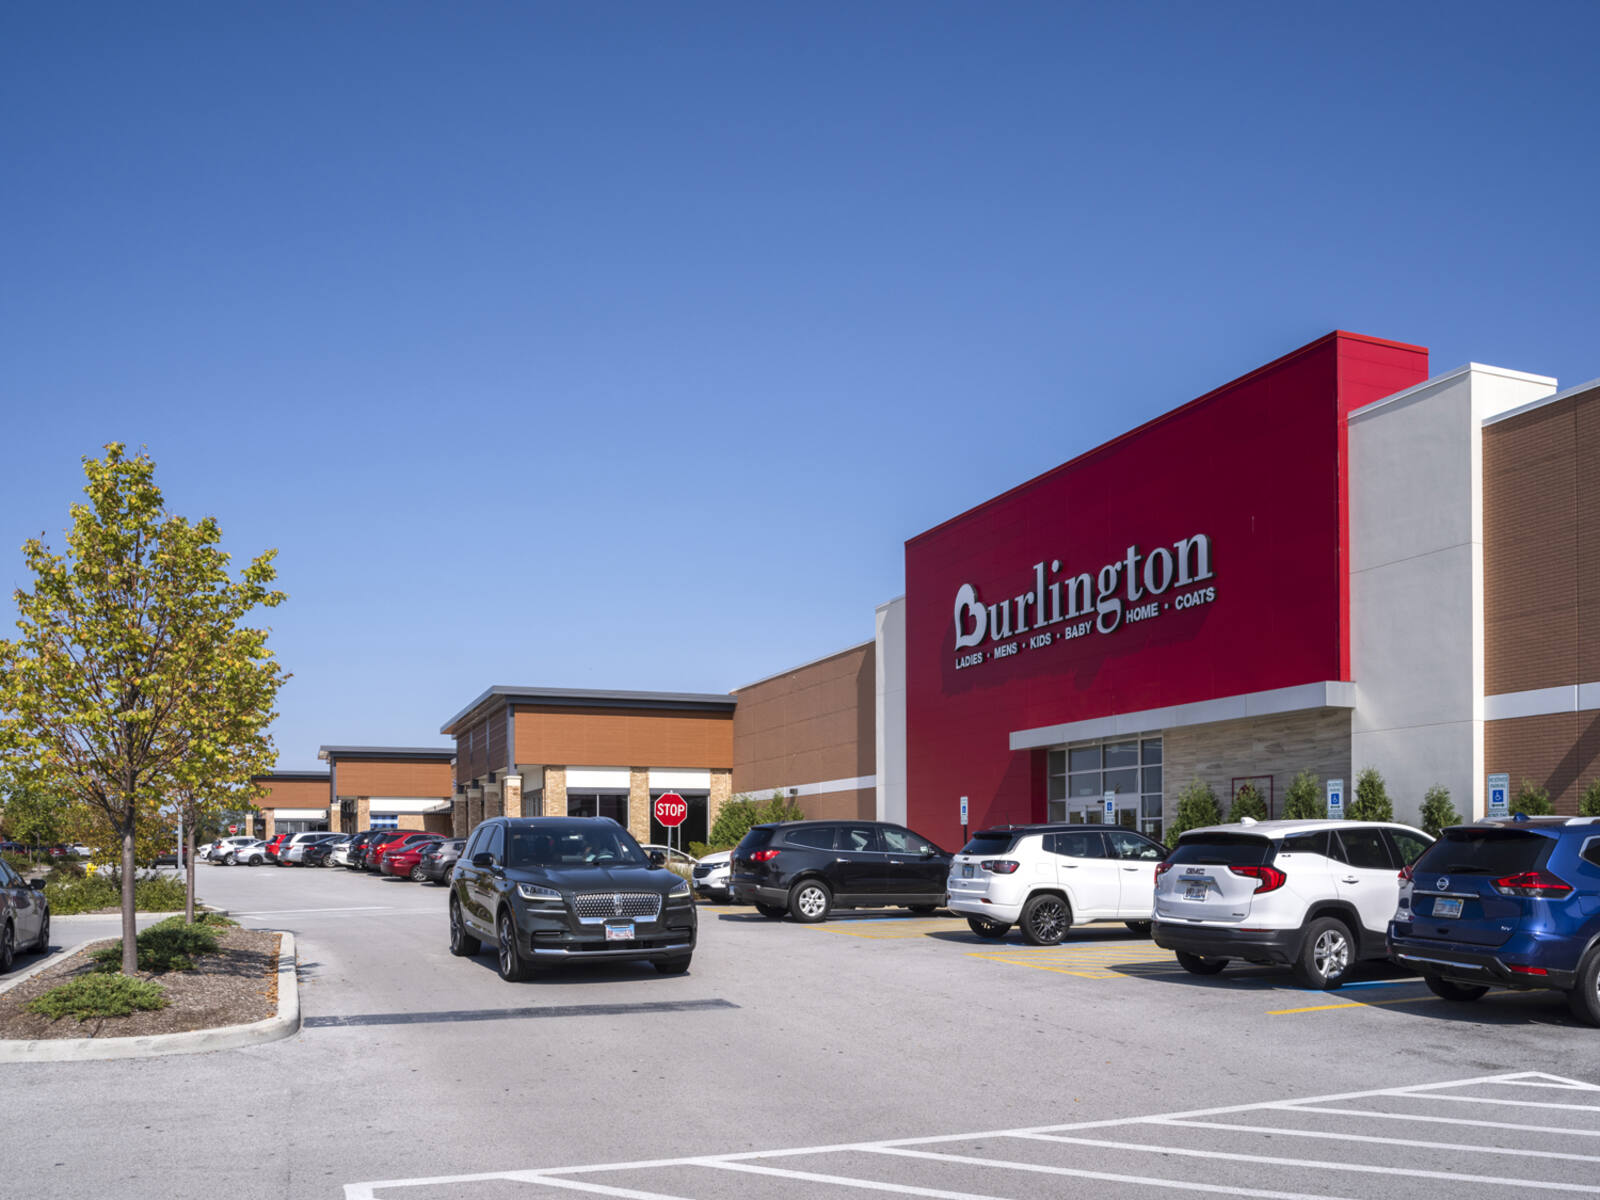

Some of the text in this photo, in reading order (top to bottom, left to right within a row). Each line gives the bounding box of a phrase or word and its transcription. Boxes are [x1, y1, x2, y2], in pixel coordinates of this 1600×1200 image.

[954, 533, 1214, 651] Burlington
[955, 586, 1216, 670] LADIES MENS KIDS BABY HOME COATS
[656, 803, 685, 817] STOP
[1186, 867, 1206, 875] GMC
